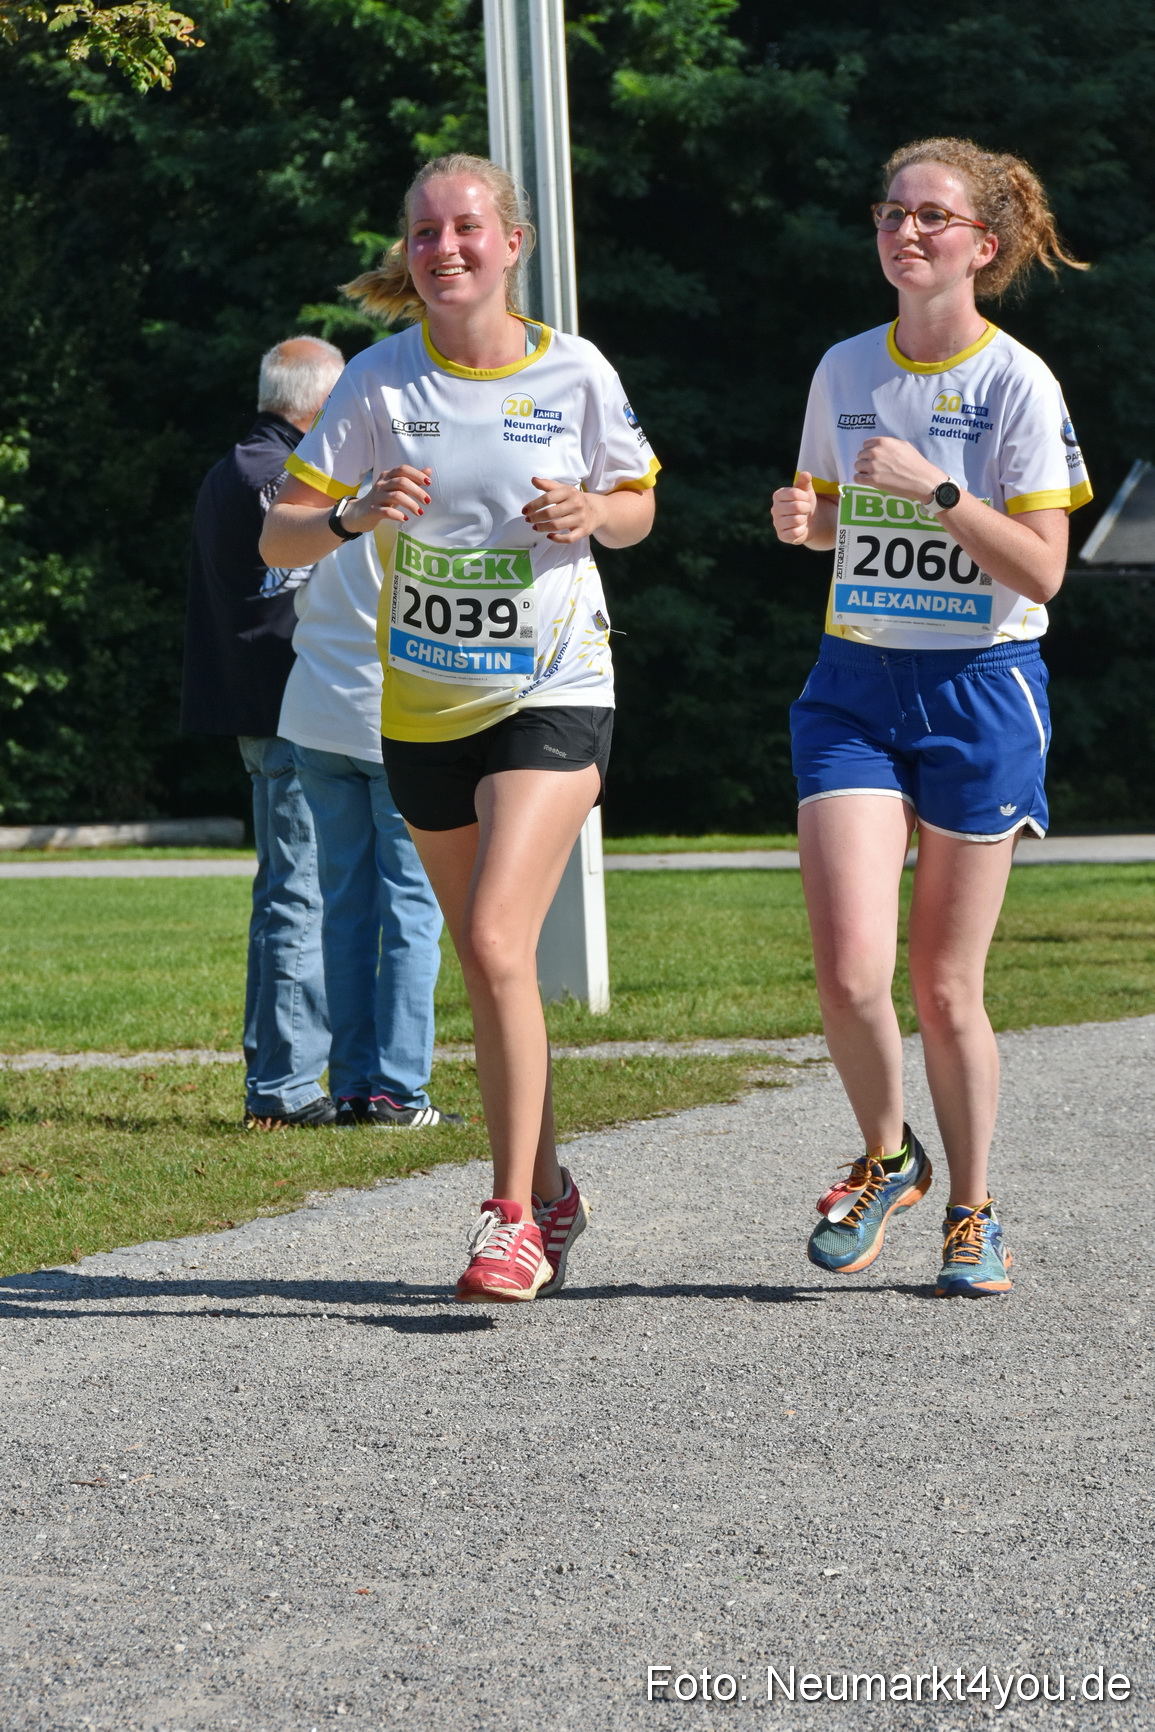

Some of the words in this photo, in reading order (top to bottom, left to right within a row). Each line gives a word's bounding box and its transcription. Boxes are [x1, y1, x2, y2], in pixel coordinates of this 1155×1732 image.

[505, 399, 533, 417] 20
[535, 409, 561, 420] JAHRE
[934, 394, 961, 413] 20
[963, 405, 987, 415] JAHRE
[391, 418, 440, 433] BOCK
[503, 419, 566, 434] Neumarkter
[838, 413, 877, 426] BOCK
[931, 414, 994, 431] Neumarkter
[503, 432, 553, 447] Stadtlauf
[928, 427, 982, 443] Stadtlauf
[402, 539, 523, 585] BOCK
[853, 535, 980, 585] 2060
[403, 585, 518, 639] 2039
[523, 601, 531, 609] D
[847, 590, 977, 616] ALEXANDRA
[405, 639, 512, 670] CHRISTIN
